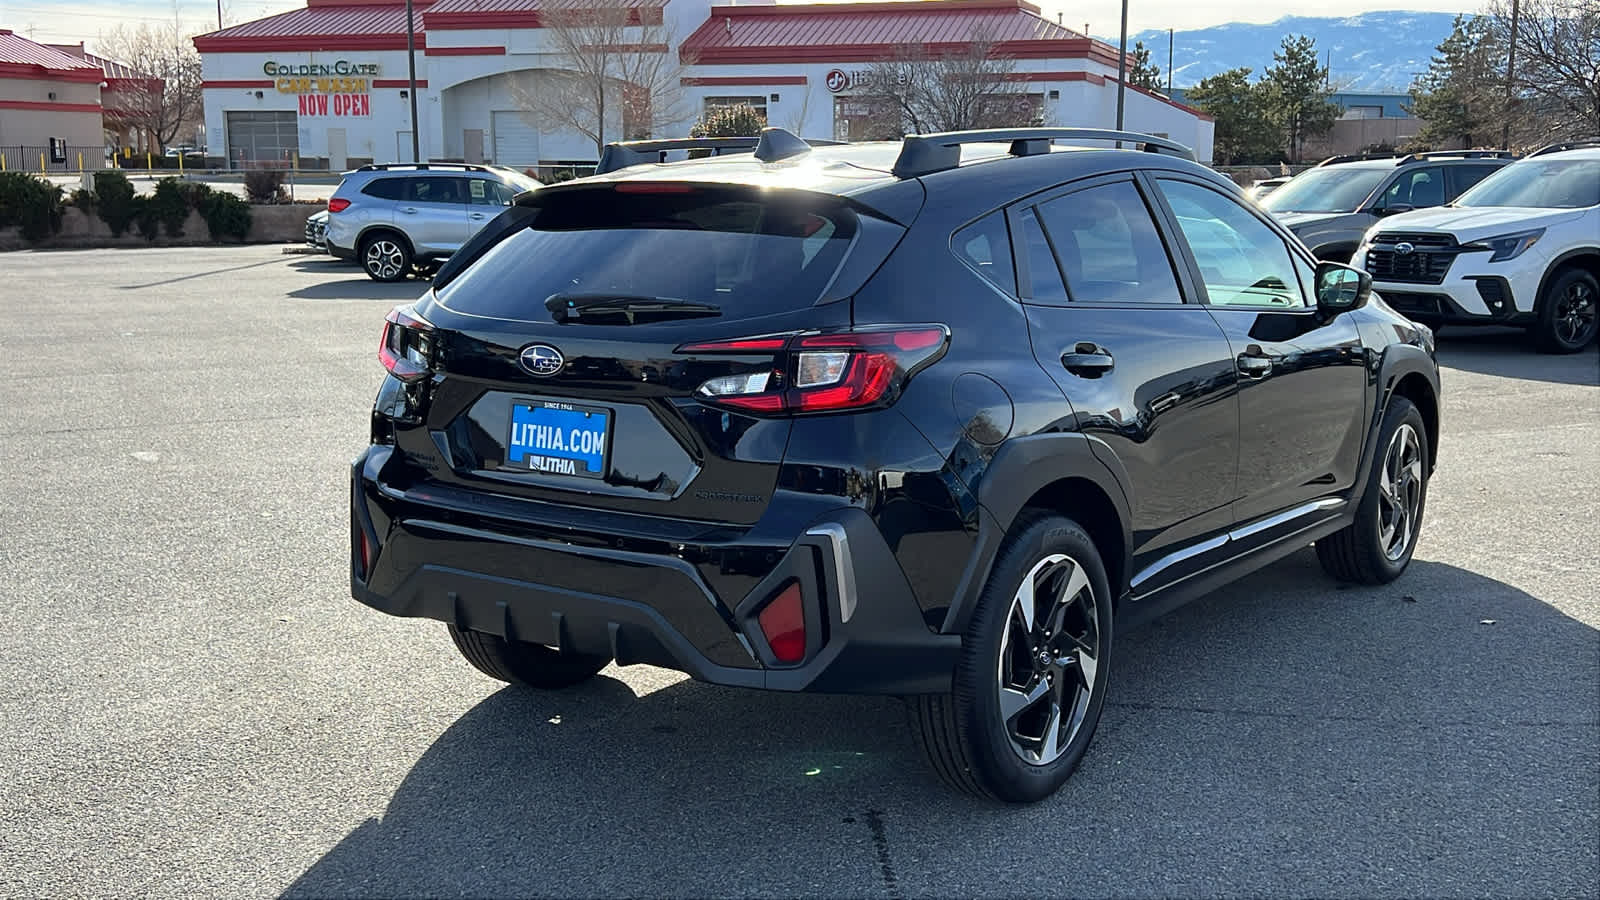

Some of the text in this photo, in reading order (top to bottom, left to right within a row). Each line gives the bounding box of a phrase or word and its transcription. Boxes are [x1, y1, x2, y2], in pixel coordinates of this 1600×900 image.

[263, 60, 378, 76] GOLDEN GATE
[276, 77, 368, 94] CAR WASH
[298, 94, 369, 116] NOW OPEN
[511, 422, 605, 455] LITHIA.COM
[541, 456, 576, 475] LITHIA
